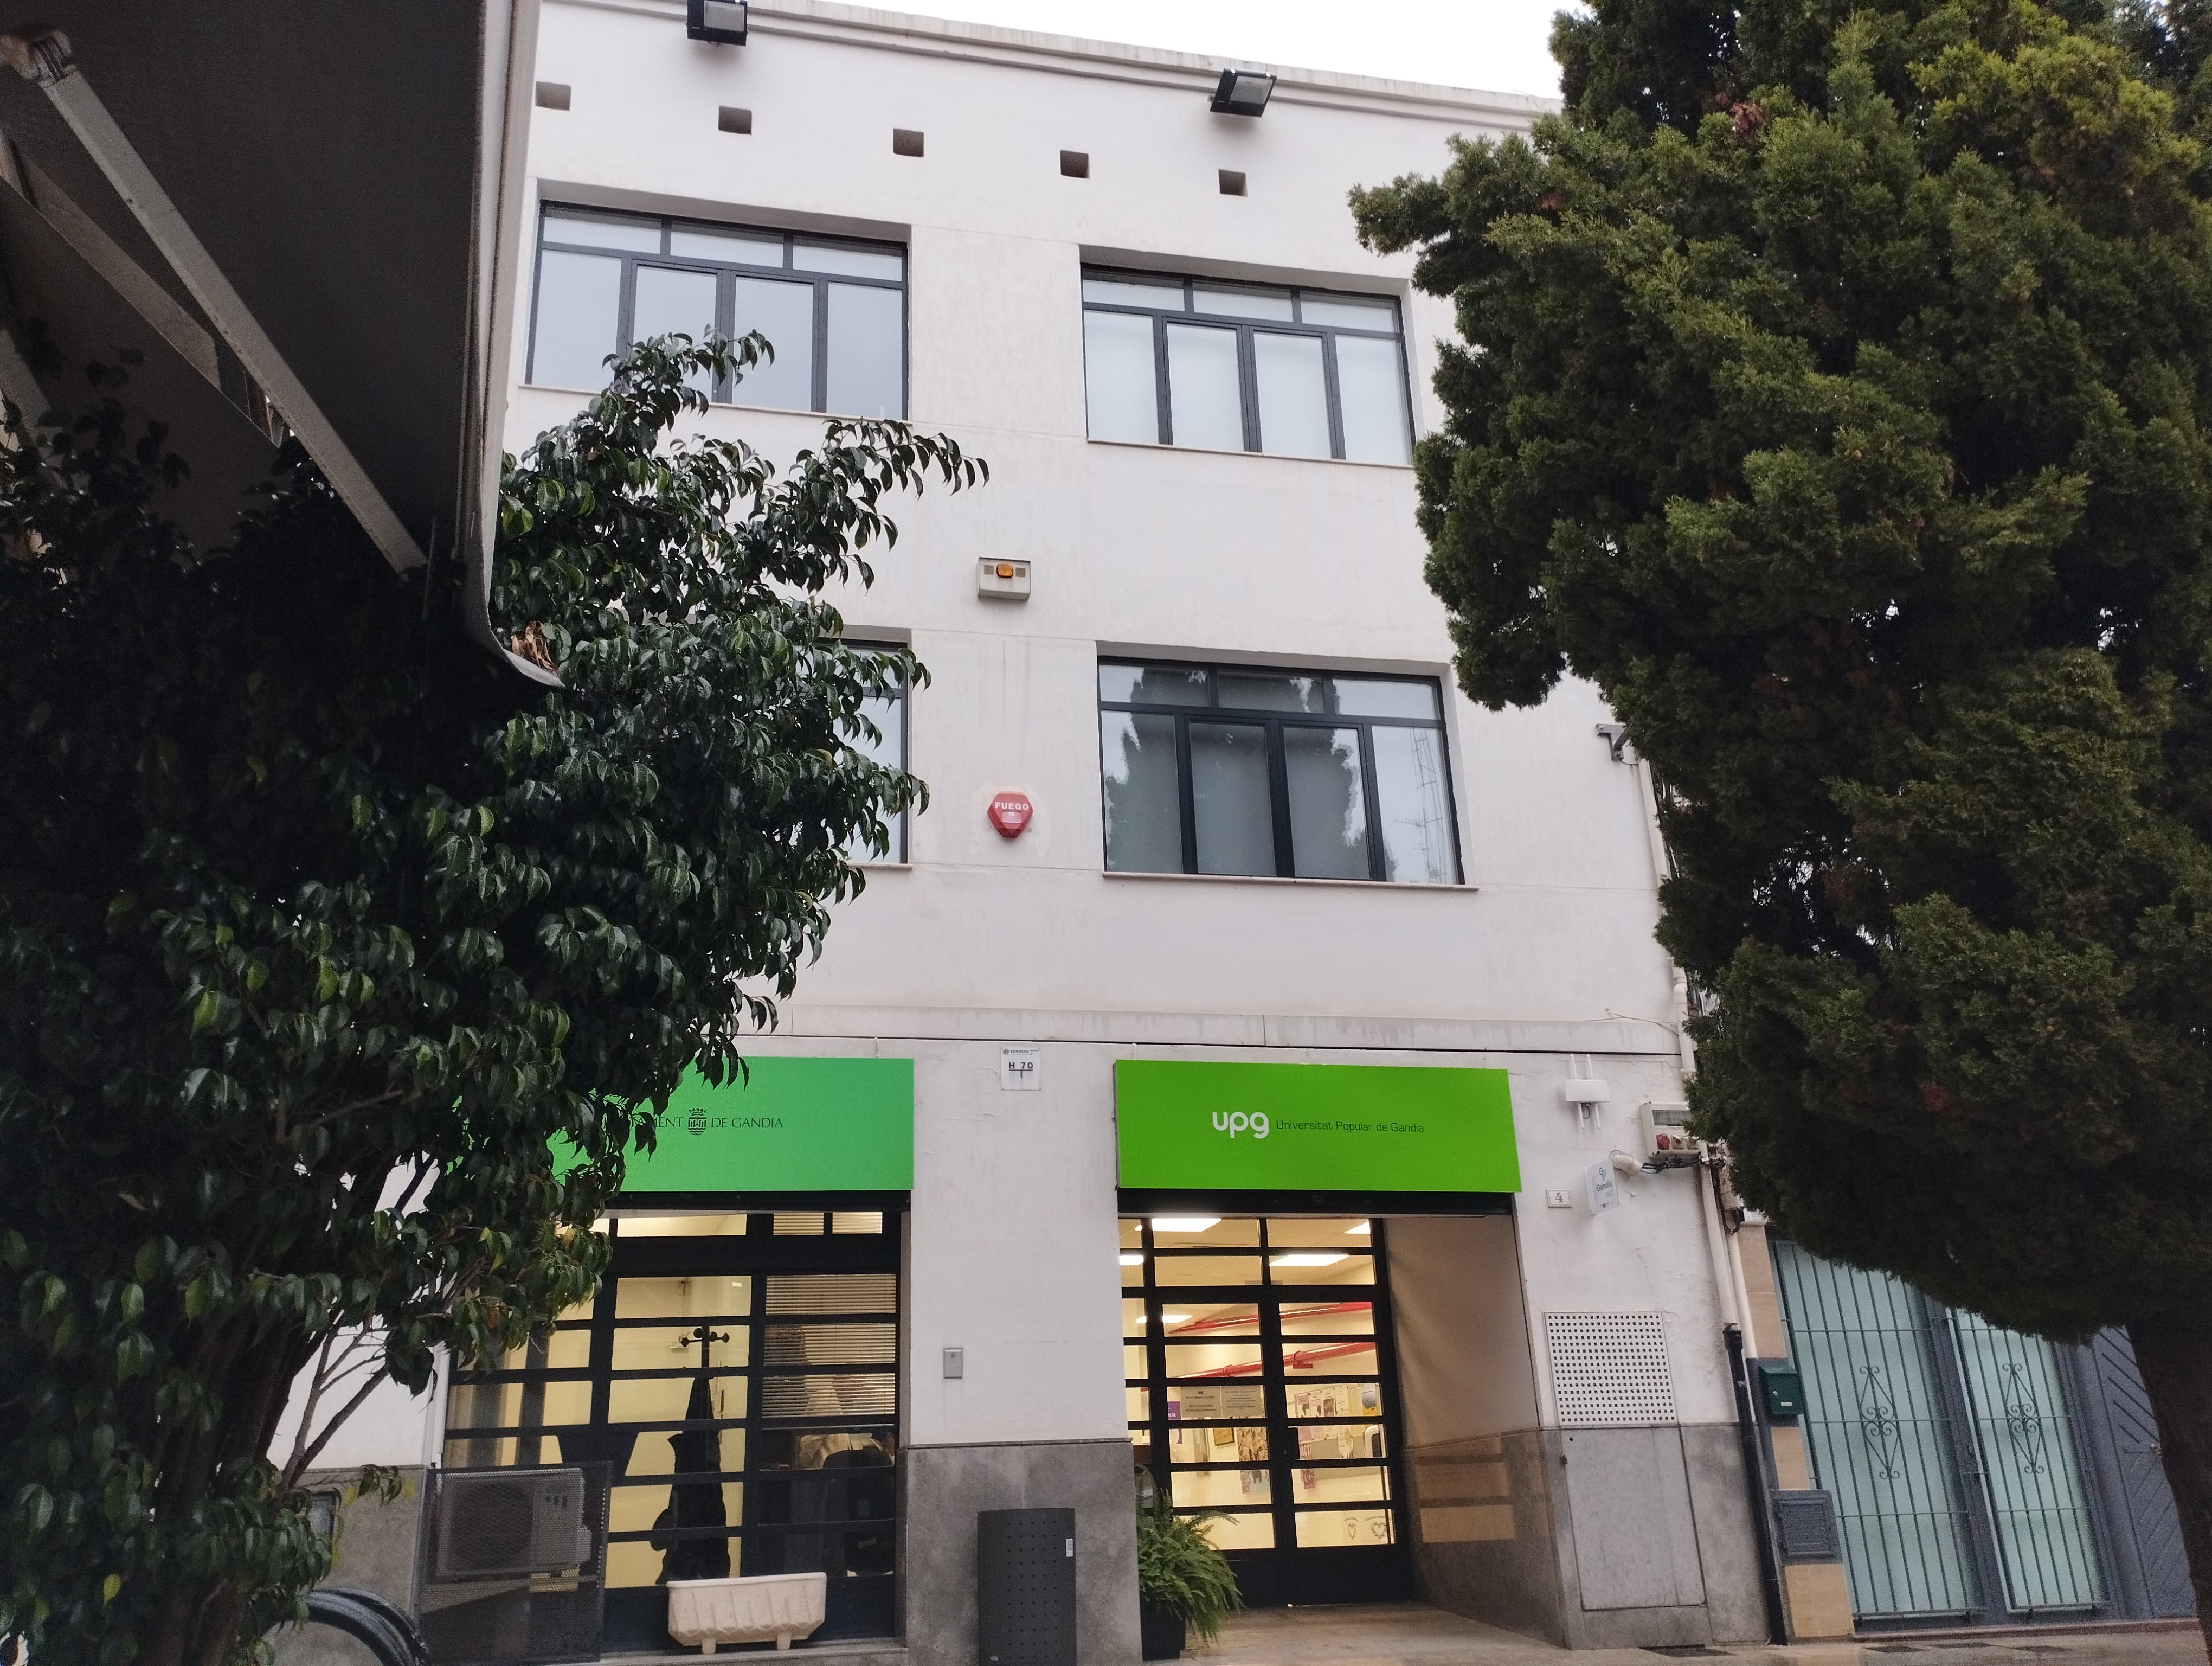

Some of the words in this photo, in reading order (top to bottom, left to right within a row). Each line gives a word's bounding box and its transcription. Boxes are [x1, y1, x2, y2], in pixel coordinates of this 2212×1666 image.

[995, 802, 1029, 811] FUEGO
[711, 1117, 728, 1128] DE
[732, 1117, 784, 1129] GANDIA
[1212, 1112, 1269, 1139] upg
[1276, 1120, 1333, 1130] Universitat
[1336, 1120, 1373, 1133] Popular
[1376, 1123, 1388, 1132] de
[1391, 1122, 1425, 1132] Gandia
[1597, 1180, 1612, 1191] Gandia
[1555, 1192, 1564, 1202] 4
